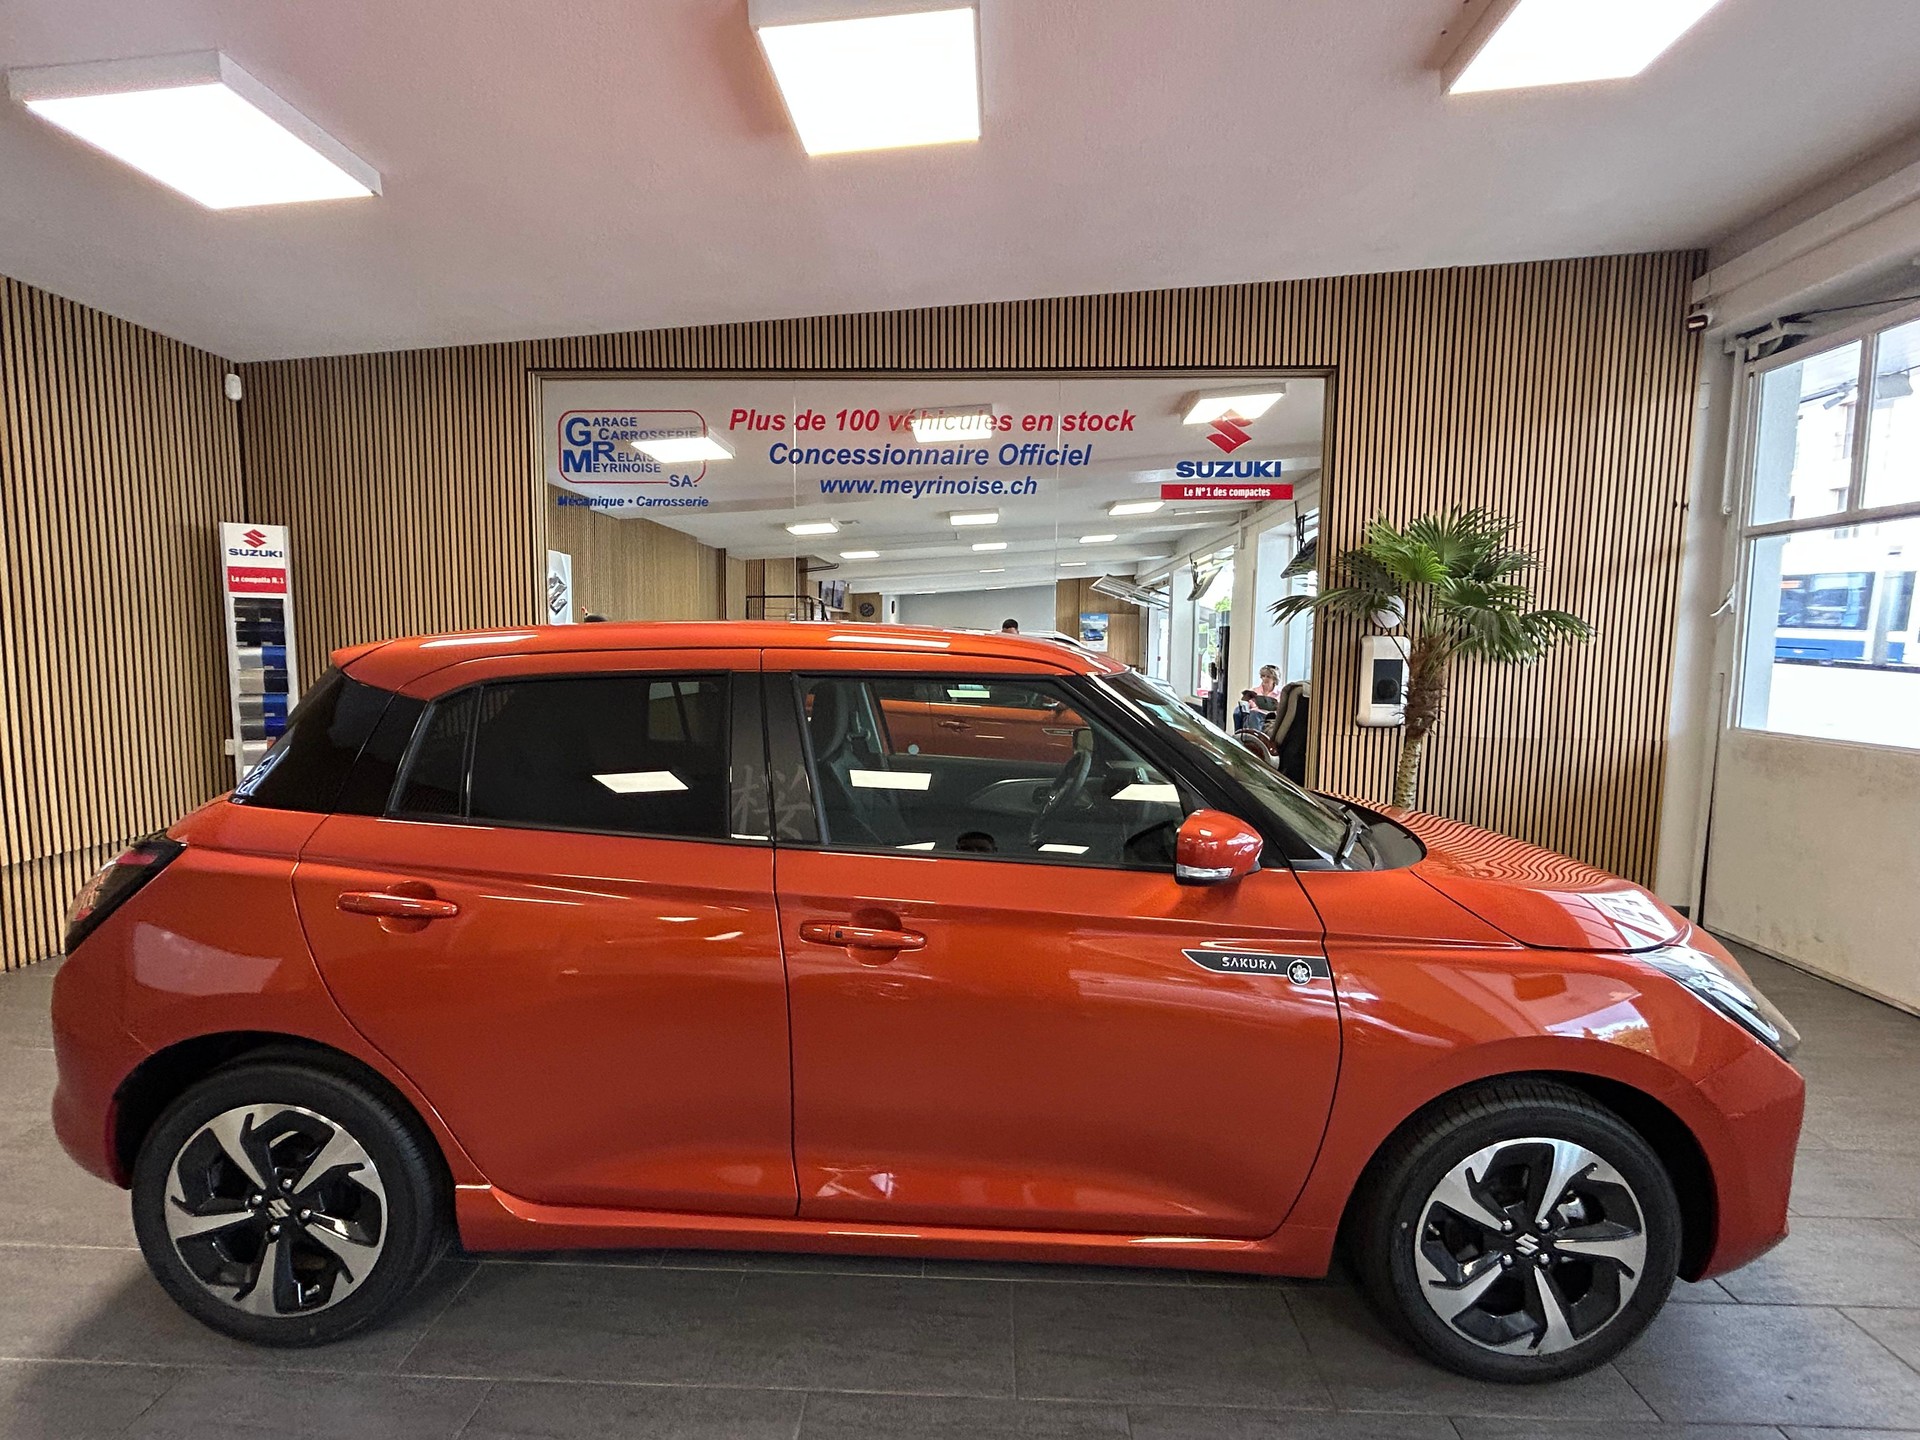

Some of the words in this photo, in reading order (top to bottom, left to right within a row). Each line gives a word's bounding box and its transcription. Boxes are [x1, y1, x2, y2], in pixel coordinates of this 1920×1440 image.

[729, 409, 786, 431] Plus
[795, 409, 826, 431] de
[836, 409, 880, 432] 100
[888, 408, 1013, 431] véhicules
[1021, 414, 1054, 431] en
[1061, 409, 1136, 431] stock
[598, 428, 697, 440] CARROSSERIE
[769, 443, 989, 465] Concessionnaire
[999, 443, 1092, 466] Officiel
[1175, 461, 1282, 478] SUZUKI
[669, 475, 697, 488] SA.
[820, 475, 1038, 498] www.meyrinoise.ch
[1183, 487, 1194, 497] Le
[1213, 487, 1227, 497] des
[1228, 487, 1271, 498] compactes
[636, 495, 709, 507] Carrosserie
[228, 548, 283, 558] SUZUKI
[1221, 956, 1277, 970] SAKURA
